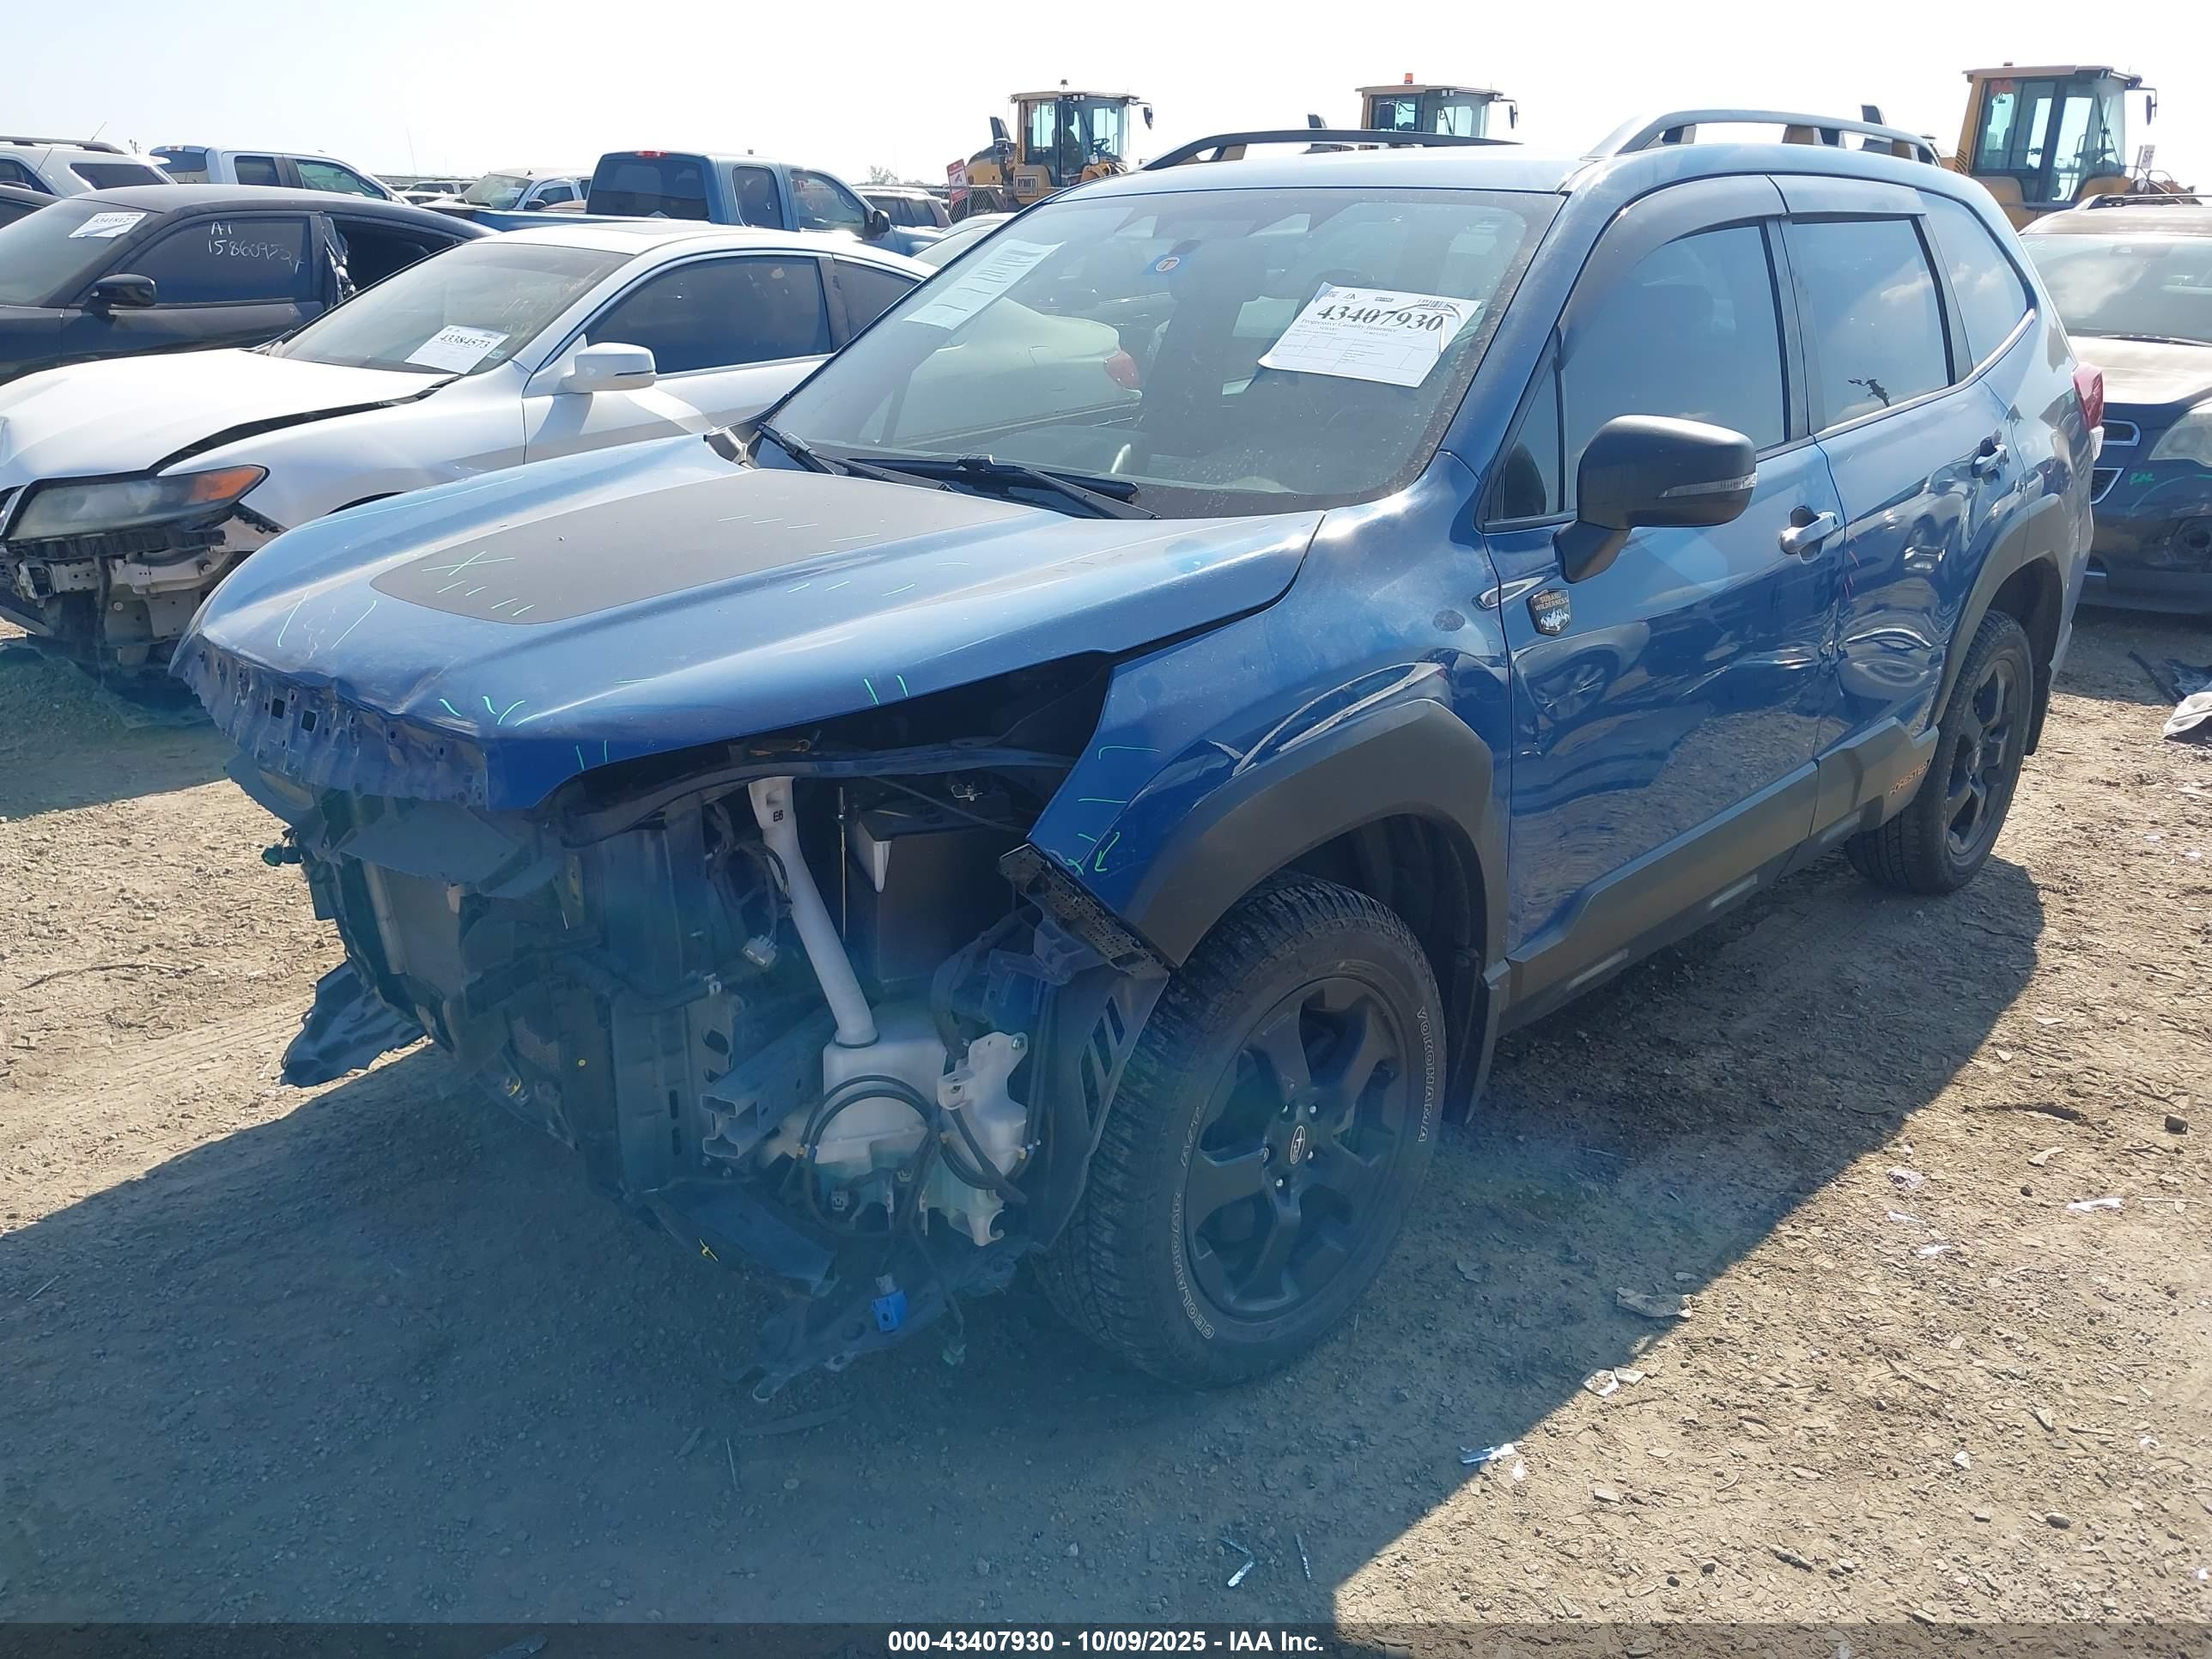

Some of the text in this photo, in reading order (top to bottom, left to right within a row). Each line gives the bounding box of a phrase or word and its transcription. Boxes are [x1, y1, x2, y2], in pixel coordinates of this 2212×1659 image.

[1316, 304, 1444, 331] 43407930
[1338, 321, 1364, 331] Casualty
[1366, 324, 1399, 333] Insurance
[1534, 597, 1569, 611] WILDERNESS
[1417, 1006, 1435, 1142] YOKOHAMA
